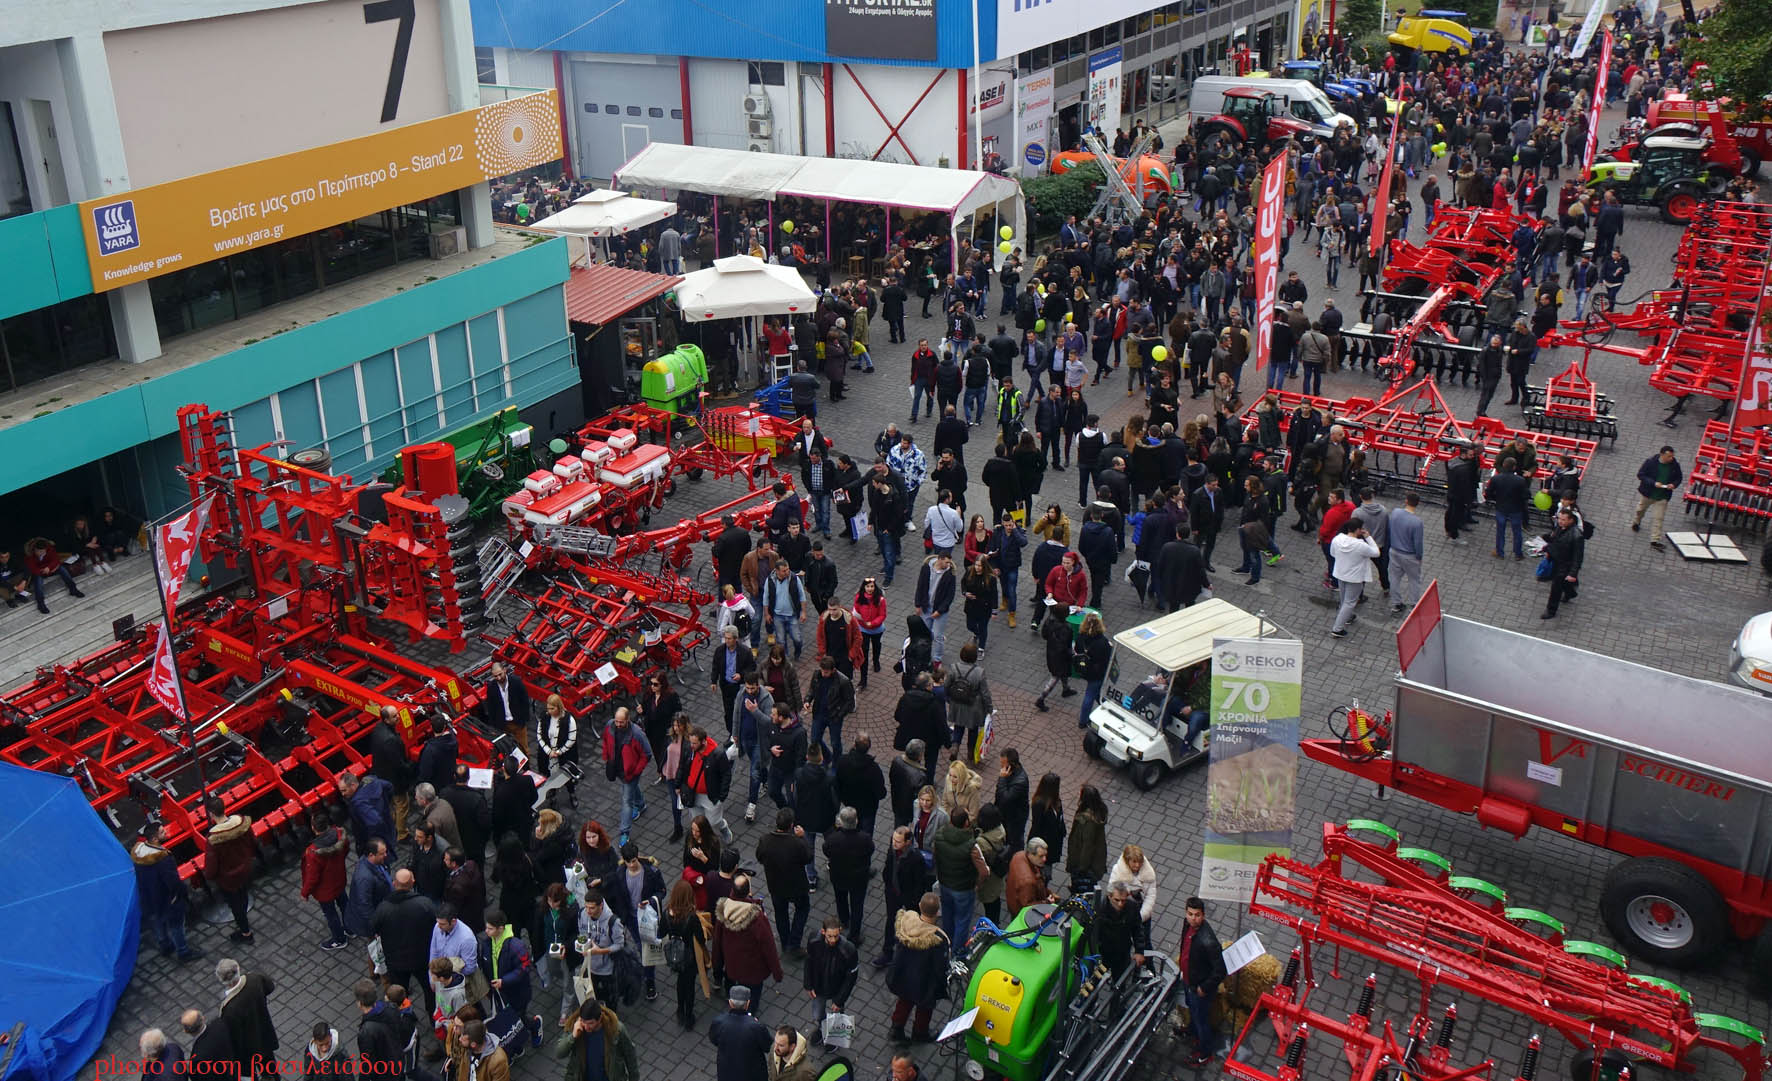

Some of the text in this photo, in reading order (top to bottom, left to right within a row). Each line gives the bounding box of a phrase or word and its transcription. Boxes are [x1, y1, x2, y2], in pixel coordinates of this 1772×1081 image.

[363, 0, 415, 123] 7
[209, 201, 257, 229] Βρείτε
[261, 194, 288, 219] μας
[291, 187, 316, 206] στο
[318, 168, 387, 198] Περίπτερο
[389, 162, 398, 179] 8
[411, 149, 446, 173] Stand
[449, 144, 464, 163] 22
[104, 235, 135, 250] YARA
[213, 224, 285, 252] www.yara.gr
[104, 253, 183, 281] Knowledge grows
[1245, 655, 1296, 668] REKOR
[315, 679, 346, 699] EXTRA
[1220, 680, 1271, 713] 70
[1218, 712, 1268, 724] ΧΡΟΝΙΑ
[1216, 723, 1268, 735] Σπέρνουμε
[1620, 754, 1737, 801] SCHIERI
[1265, 912, 1290, 926] REKOR
[988, 997, 1011, 1013] REKOR
[1631, 1045, 1662, 1062] REKOR
